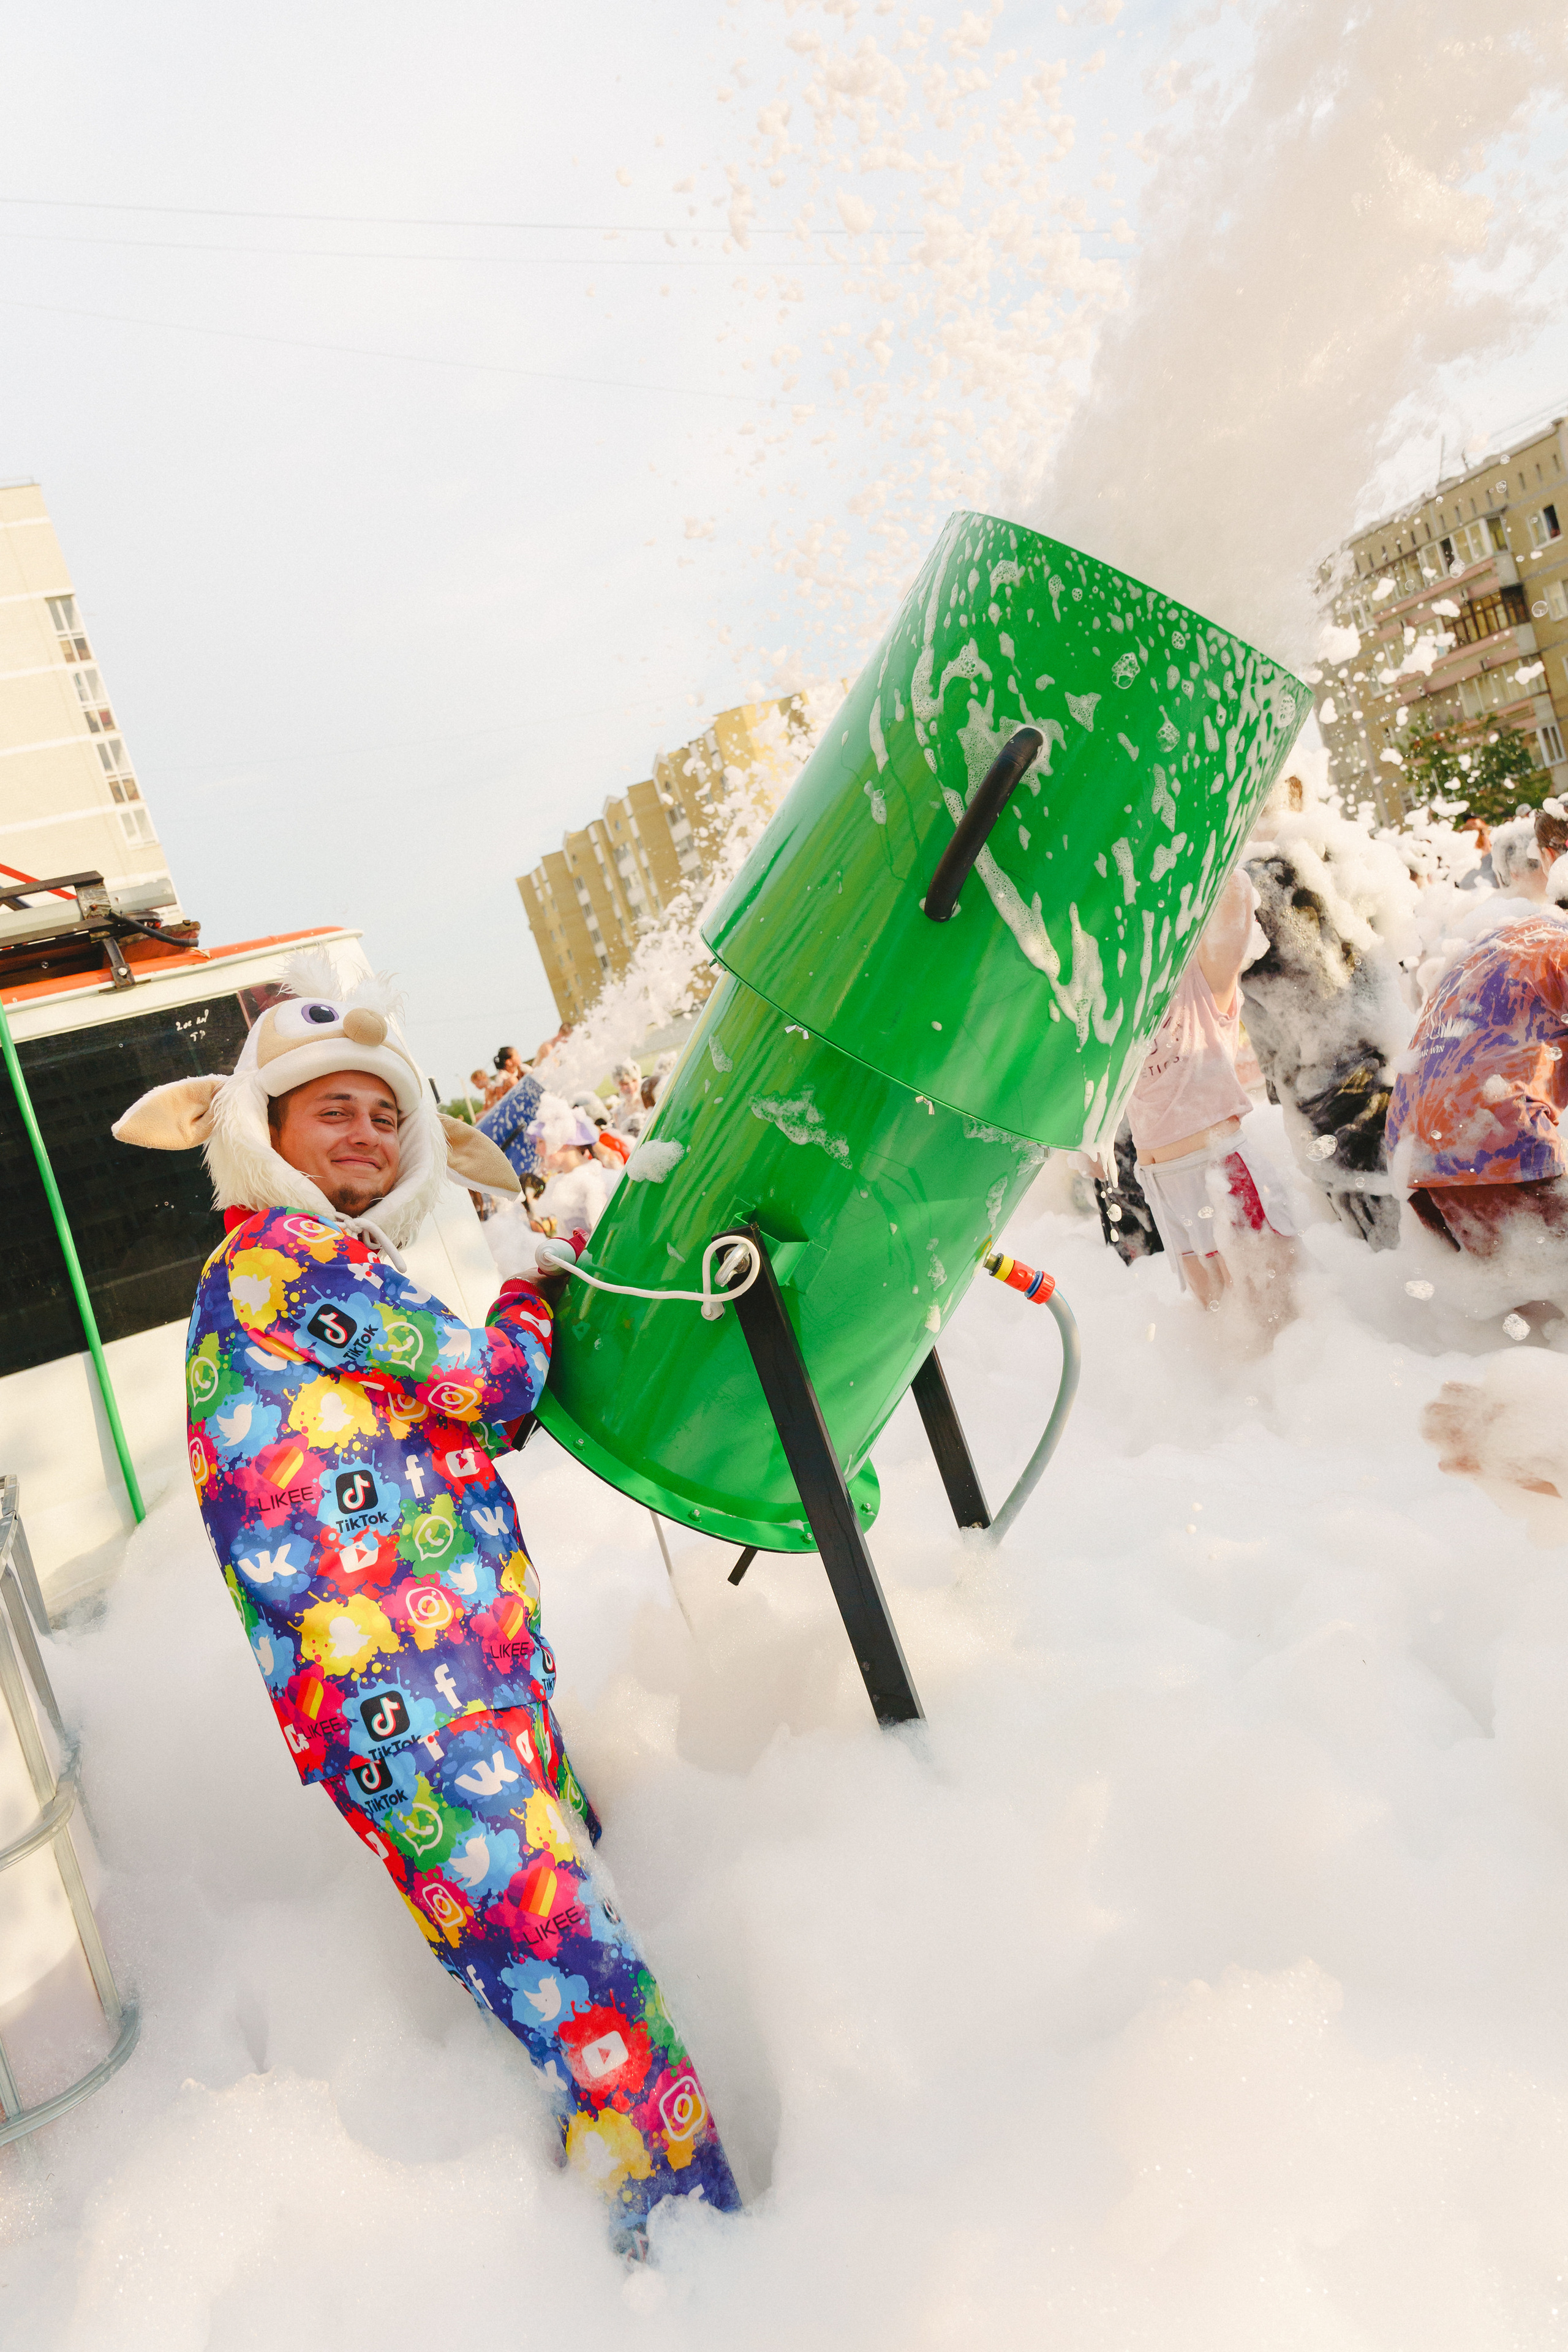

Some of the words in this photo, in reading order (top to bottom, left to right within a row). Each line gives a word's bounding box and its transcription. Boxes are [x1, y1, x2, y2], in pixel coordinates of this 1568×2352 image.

[343, 1324, 379, 1360] TikTok
[404, 1454, 425, 1499] f
[258, 1487, 314, 1511] LIKEE
[336, 1511, 389, 1533] TikTok
[470, 1506, 510, 1536] VK
[237, 1544, 297, 1583] VK
[491, 1642, 529, 1659] LIKEE
[434, 1663, 462, 1709] f
[300, 1717, 343, 1740] LIKEE
[454, 1750, 519, 1795] VK
[364, 1789, 409, 1813] TikTok
[522, 1905, 582, 1945] LIKEE
